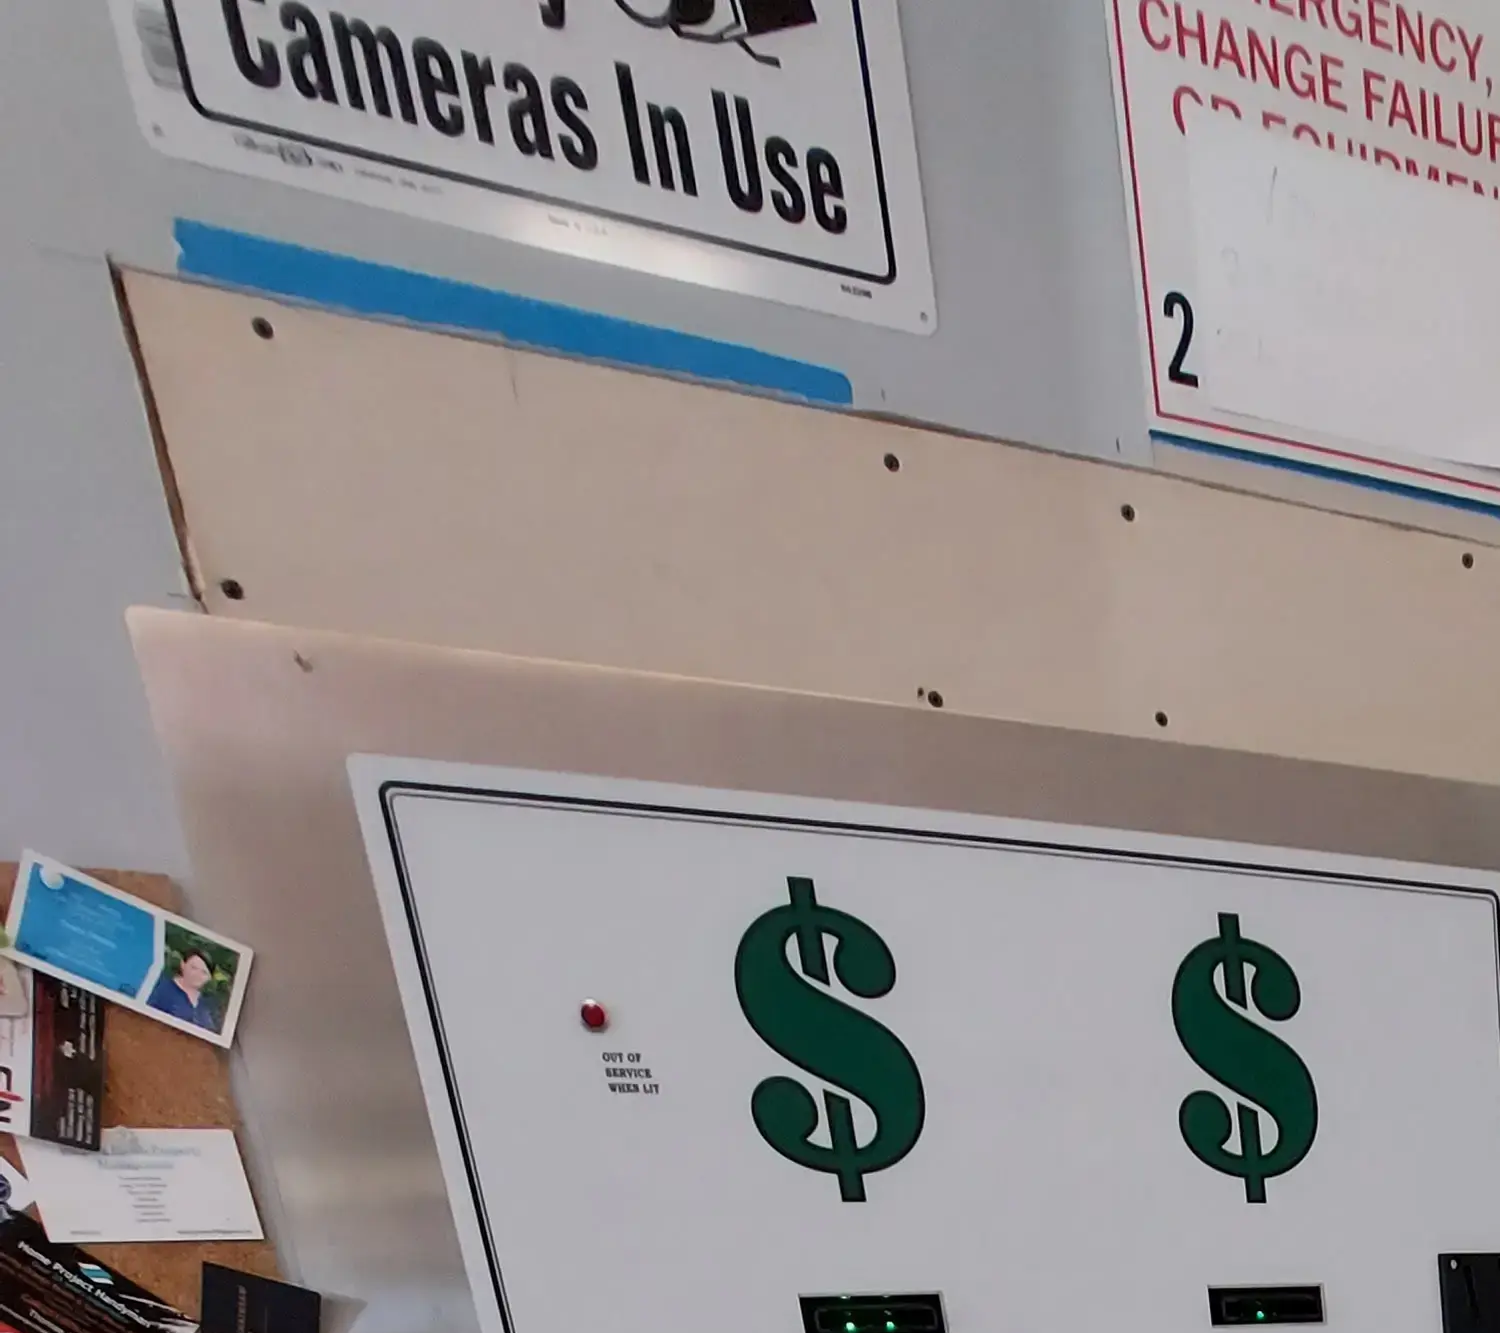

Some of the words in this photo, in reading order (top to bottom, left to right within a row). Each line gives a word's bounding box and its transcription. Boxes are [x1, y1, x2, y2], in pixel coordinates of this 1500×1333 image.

[1138, 0, 1348, 112] CHANGE
[226, 0, 598, 171] Cameras
[614, 61, 698, 197] In
[710, 88, 848, 235] Use
[602, 1052, 623, 1063] OUT
[627, 1053, 641, 1063] OF
[605, 1067, 652, 1079] SERVICE
[608, 1082, 639, 1093] WHEN
[643, 1083, 659, 1094] LIT
